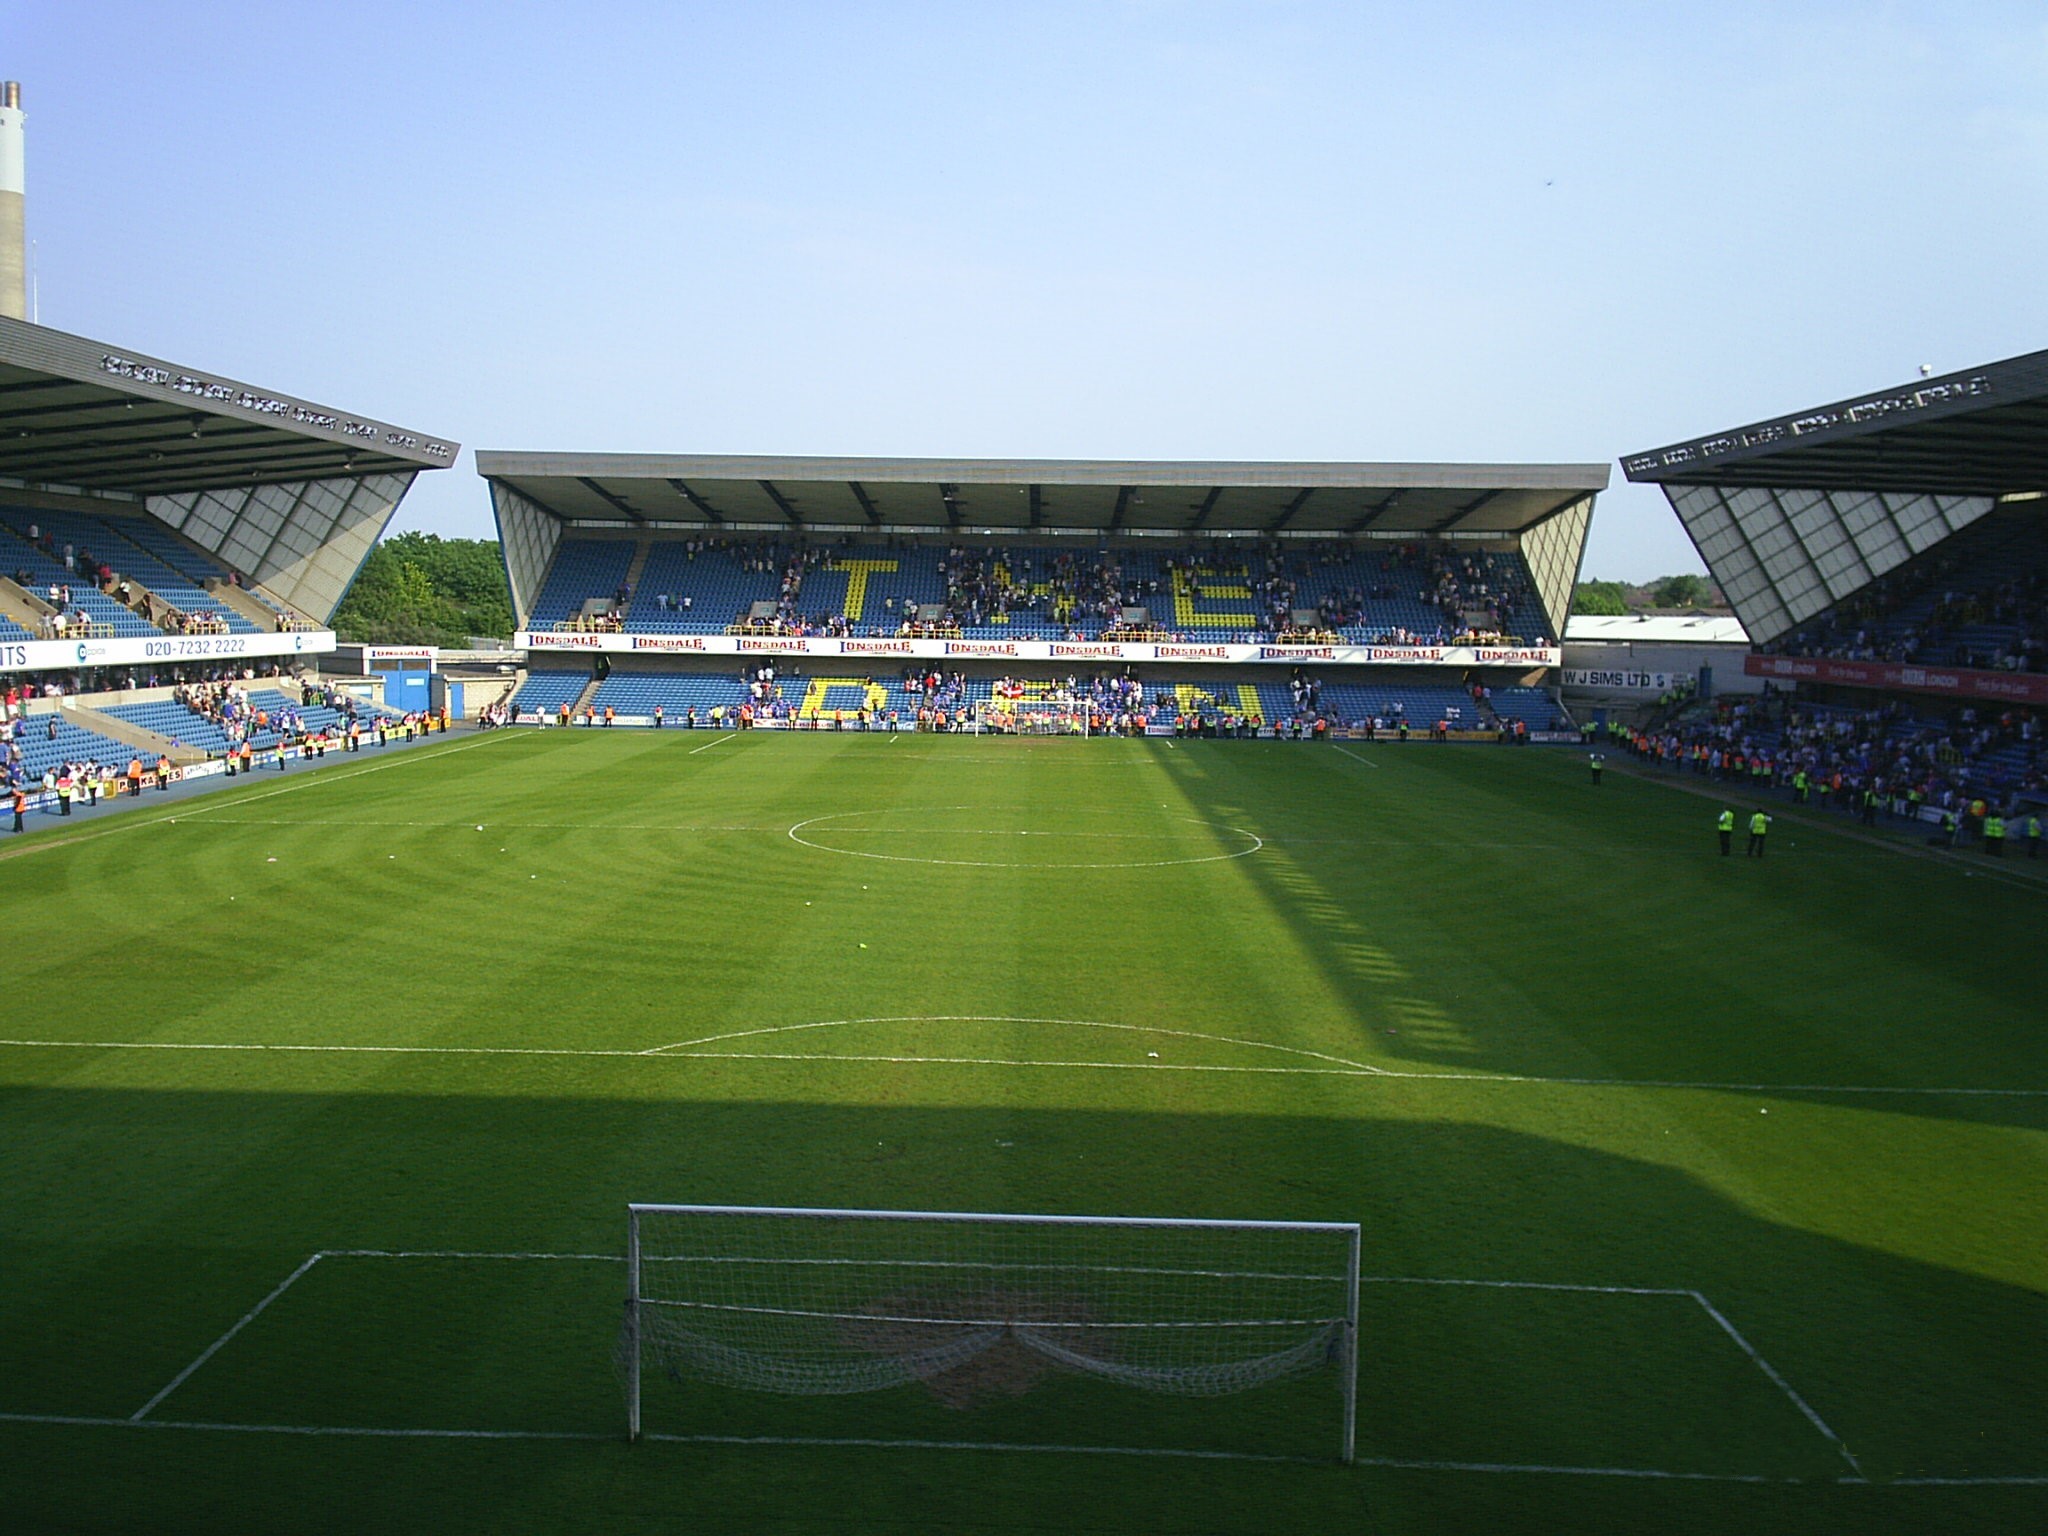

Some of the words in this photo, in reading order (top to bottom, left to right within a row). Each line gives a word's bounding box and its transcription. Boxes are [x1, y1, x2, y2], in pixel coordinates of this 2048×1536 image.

[529, 635, 599, 647] LONSDALE
[632, 637, 703, 649] LONSDALE
[736, 639, 806, 651] LONSDALE
[840, 641, 911, 653] LONSDALE
[145, 641, 210, 656] 020-7232
[215, 639, 246, 653] 2222
[944, 643, 1015, 654] LONSDALE
[1049, 644, 1121, 656] LONSDALE
[1154, 646, 1226, 658] LONSDALE
[1260, 647, 1332, 659] LONSDALE
[0, 645, 26, 666] TS
[1366, 648, 1440, 660] LONSDALE
[1475, 649, 1549, 661] LONSDALE
[1564, 671, 1576, 684] W
[1579, 672, 1587, 684] J
[1590, 672, 1623, 685] SIMS
[1628, 673, 1650, 687] LTD
